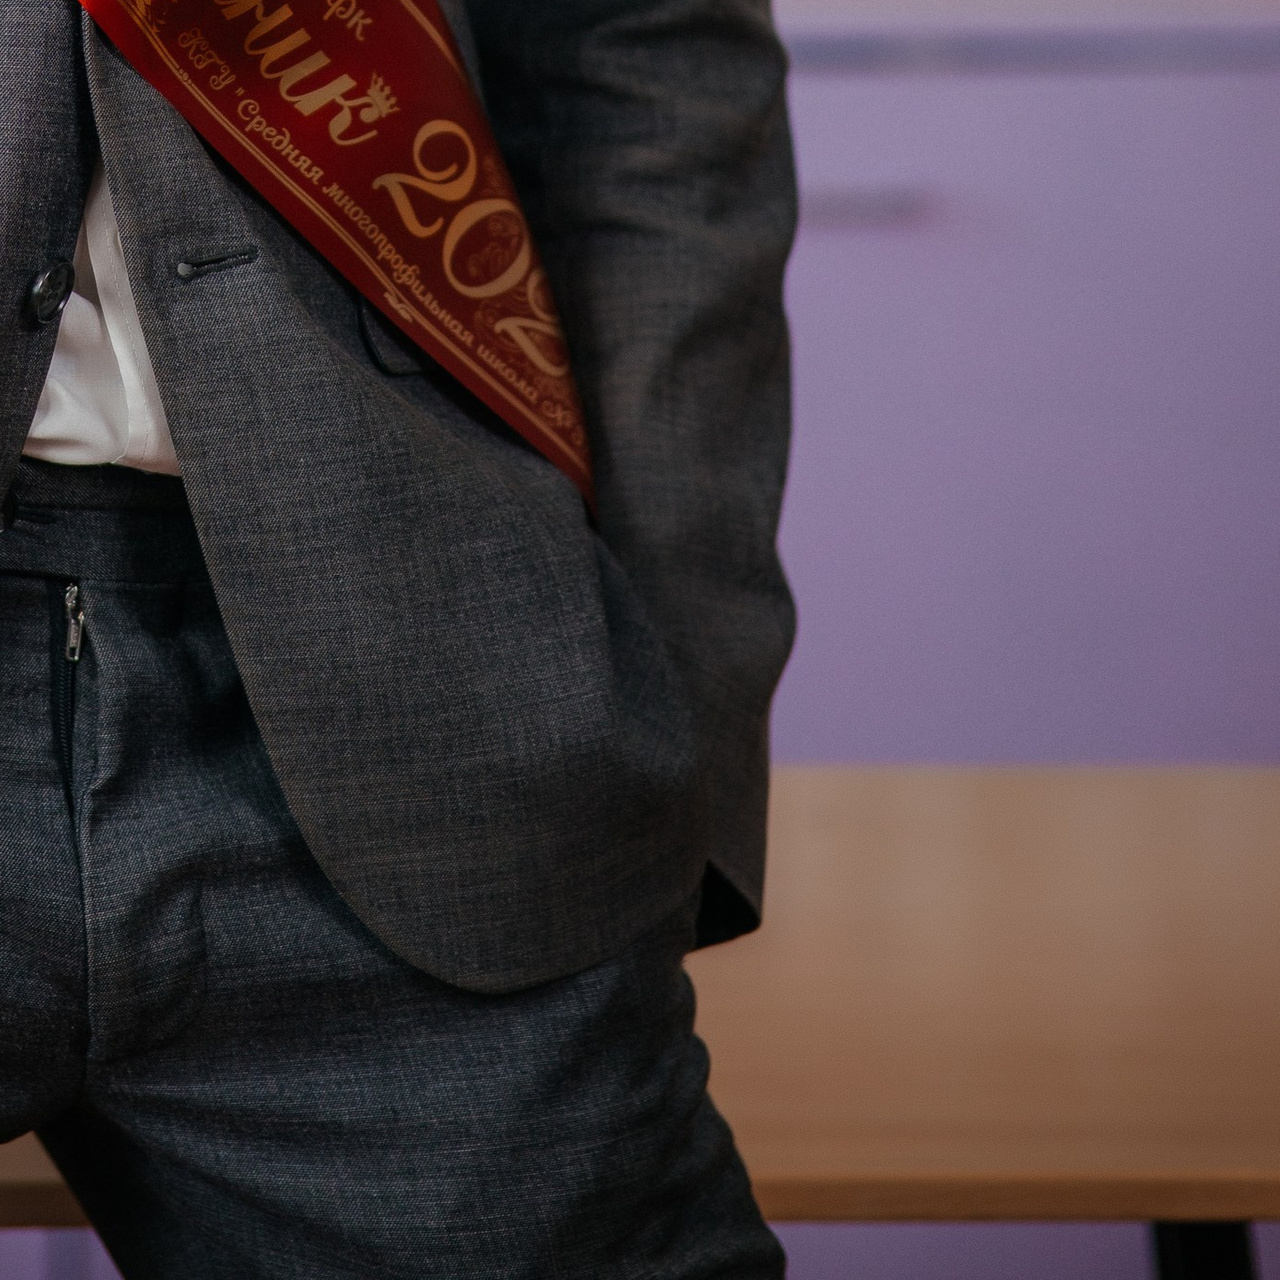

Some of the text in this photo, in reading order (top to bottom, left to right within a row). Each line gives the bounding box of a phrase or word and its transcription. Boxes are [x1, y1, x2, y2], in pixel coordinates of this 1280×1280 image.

[177, 27, 236, 91] КГУ
[322, 181, 475, 343] многопрофильная
[477, 344, 538, 410] школа
